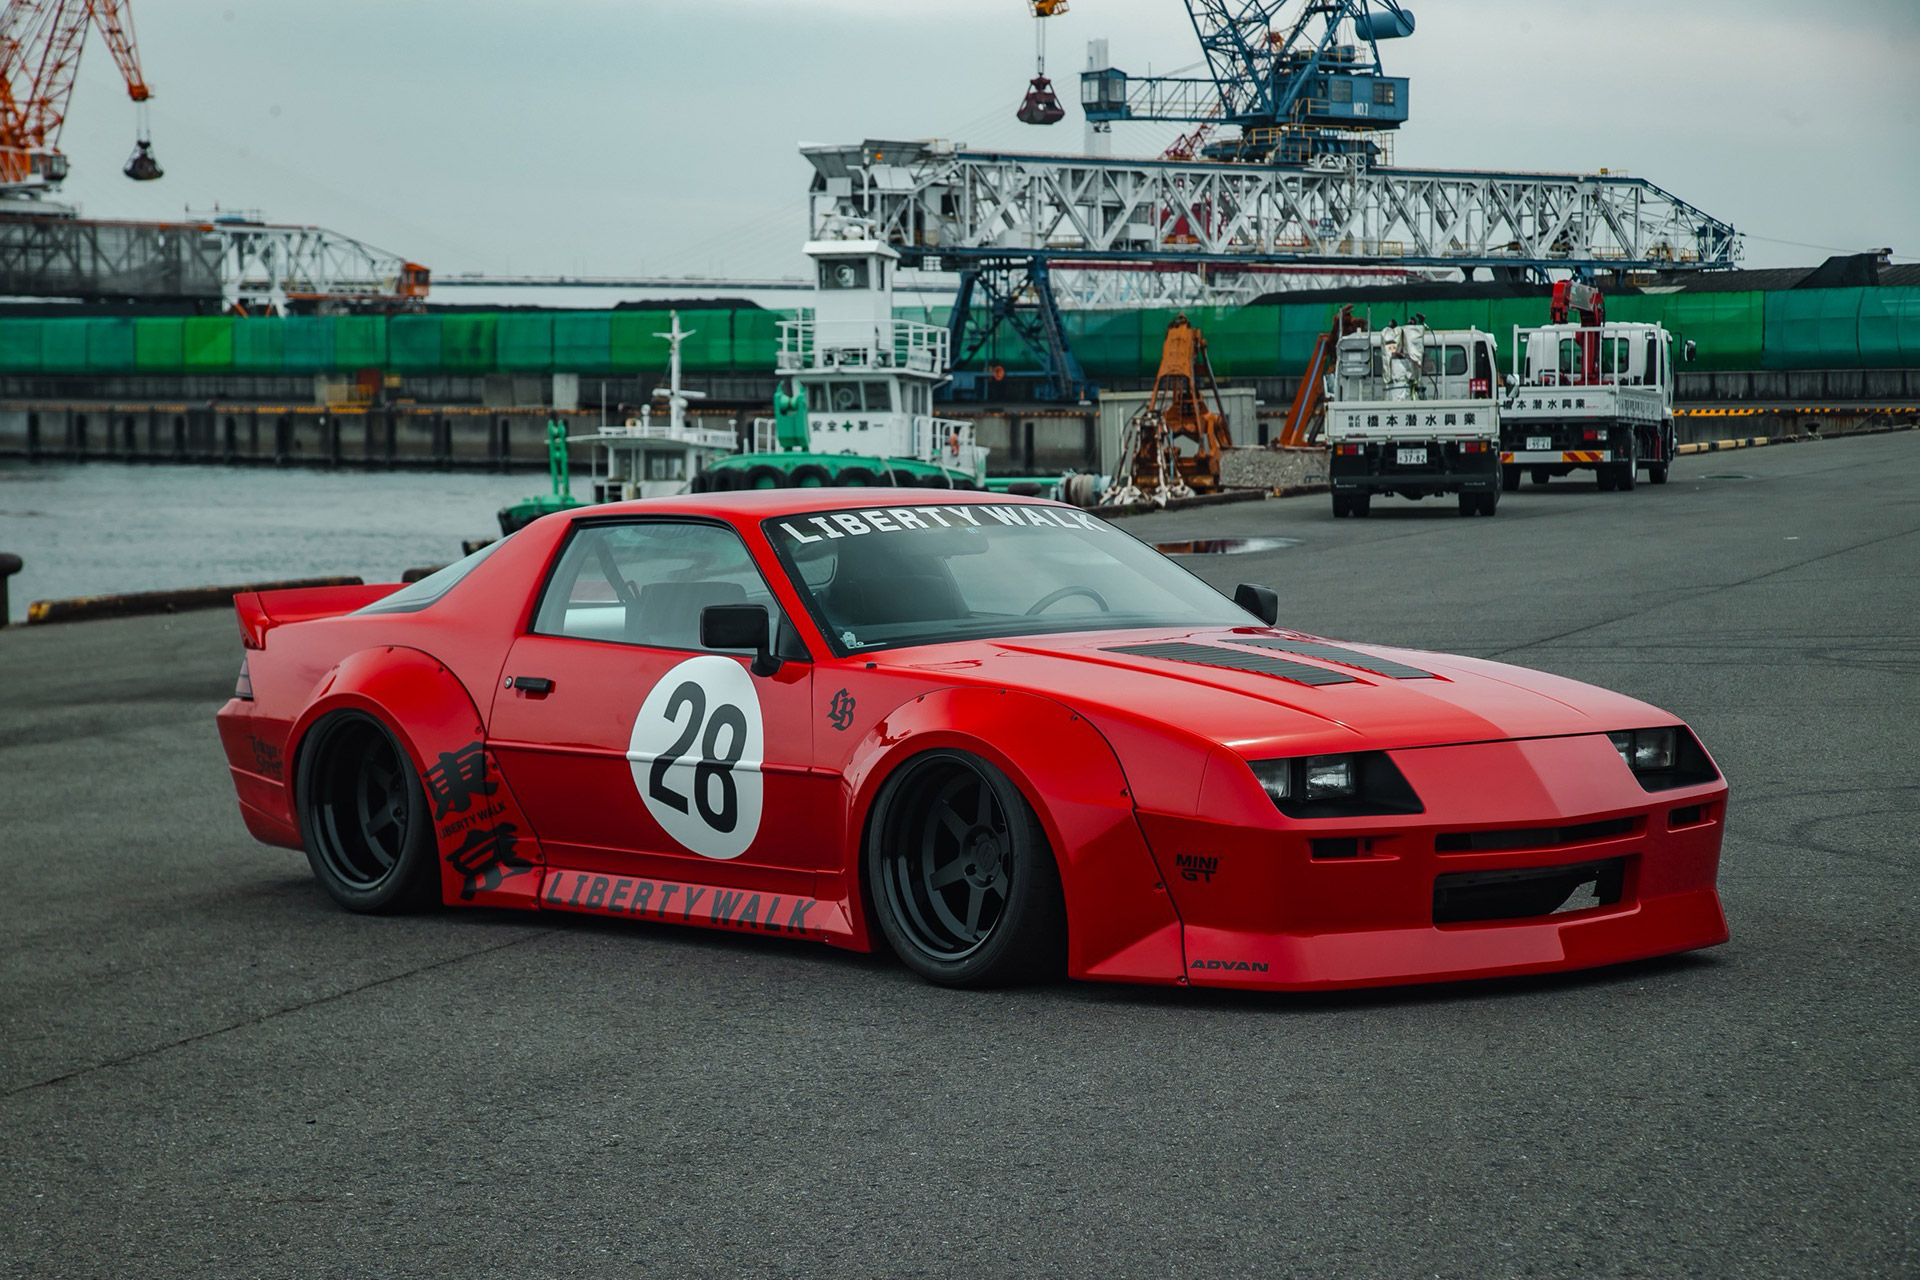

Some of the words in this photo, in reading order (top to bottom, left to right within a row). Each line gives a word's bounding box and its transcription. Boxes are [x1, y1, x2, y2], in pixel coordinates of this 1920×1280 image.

[780, 506, 982, 544] LIBERTY
[978, 506, 1109, 532] WALK
[649, 681, 747, 833] 28
[439, 815, 476, 840] LIBERTY
[477, 801, 507, 822] WALK
[1176, 854, 1218, 869] MINI
[1181, 868, 1216, 883] GT
[546, 872, 705, 920] LIBERTY
[710, 890, 816, 934] WALK
[1190, 960, 1269, 972] ADVAN
